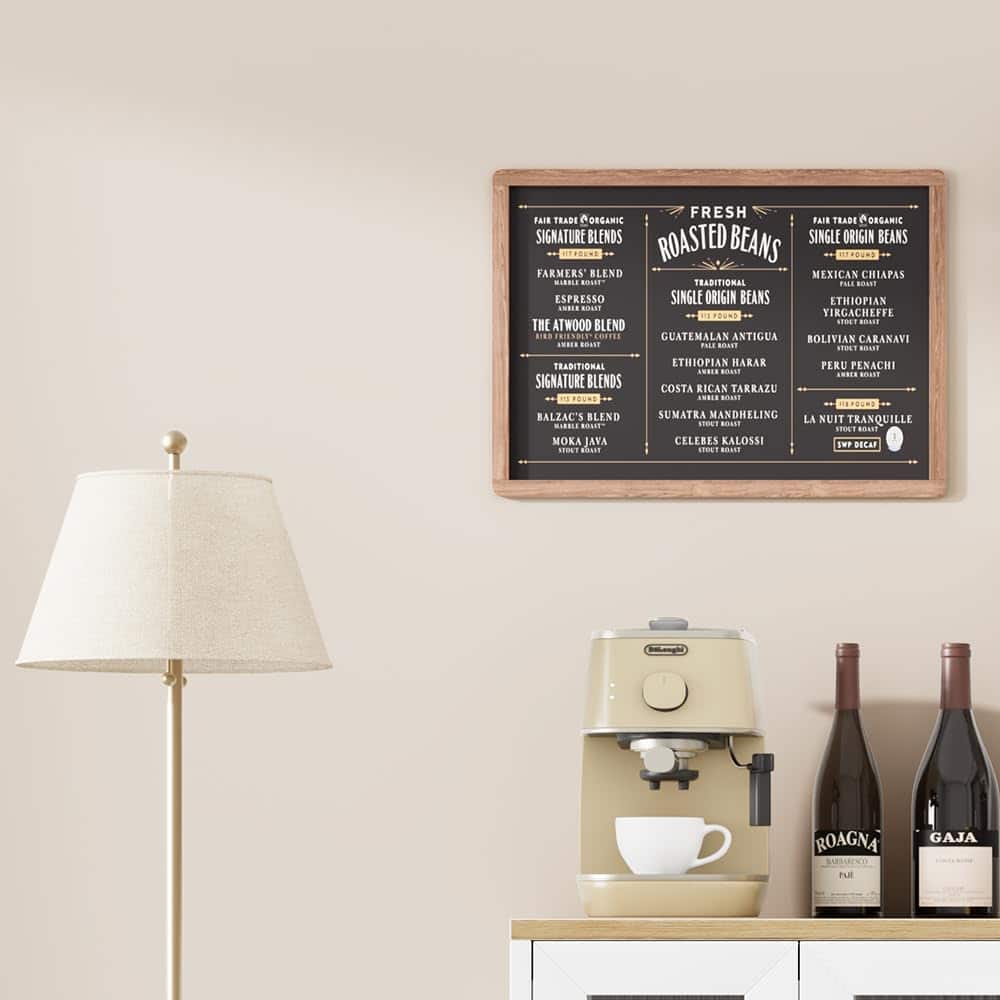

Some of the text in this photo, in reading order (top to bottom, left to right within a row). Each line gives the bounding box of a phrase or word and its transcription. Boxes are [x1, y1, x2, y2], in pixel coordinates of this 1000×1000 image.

[690, 206, 747, 219] FRESH
[534, 216, 624, 225] FAIR TRADE ORGANIC
[813, 216, 903, 225] FAIR TRADE ORGANIC
[536, 229, 623, 244] SIGNATURE BLENDS
[809, 229, 908, 244] SINGLE ORIGIN BEANS
[657, 223, 782, 264] ROASTED BEANS
[537, 268, 623, 278] FARMERS' BLEND
[812, 270, 905, 279] MEXICAN CHIAPAS
[694, 279, 746, 287] TRADITIONAL
[555, 294, 605, 304] ESPRESSO
[670, 290, 770, 305] SINGLE ORIGIN BEANS
[830, 296, 887, 306] ETHIOPIAN
[823, 308, 894, 317] YIRGACHEFFE
[532, 318, 625, 331] THE ATWOOD BLEND
[661, 331, 778, 341] GUATEMALAN ANTIGUA
[807, 334, 910, 344] BOLIVIAN CARANAVI
[553, 362, 605, 371] TRADITIONAL
[672, 358, 767, 368] ETHIOPIAN HARAR
[821, 361, 896, 370] PERU PENACHI
[535, 373, 622, 389] SIGNATURE BLENDS
[661, 384, 778, 393] COSTA RICAN TARRAZU
[537, 412, 620, 421] BALZAC'S BLEND
[658, 410, 779, 420] SUMATRA MANDHELING
[803, 414, 913, 427] LA NUIT TRANQUILLE
[552, 436, 608, 448] MOKA JAVA
[674, 436, 764, 446] CELEBES KALOSSI
[854, 441, 878, 449] DECAF
[815, 830, 878, 854] ROAGNA
[929, 831, 978, 843] GAJA
